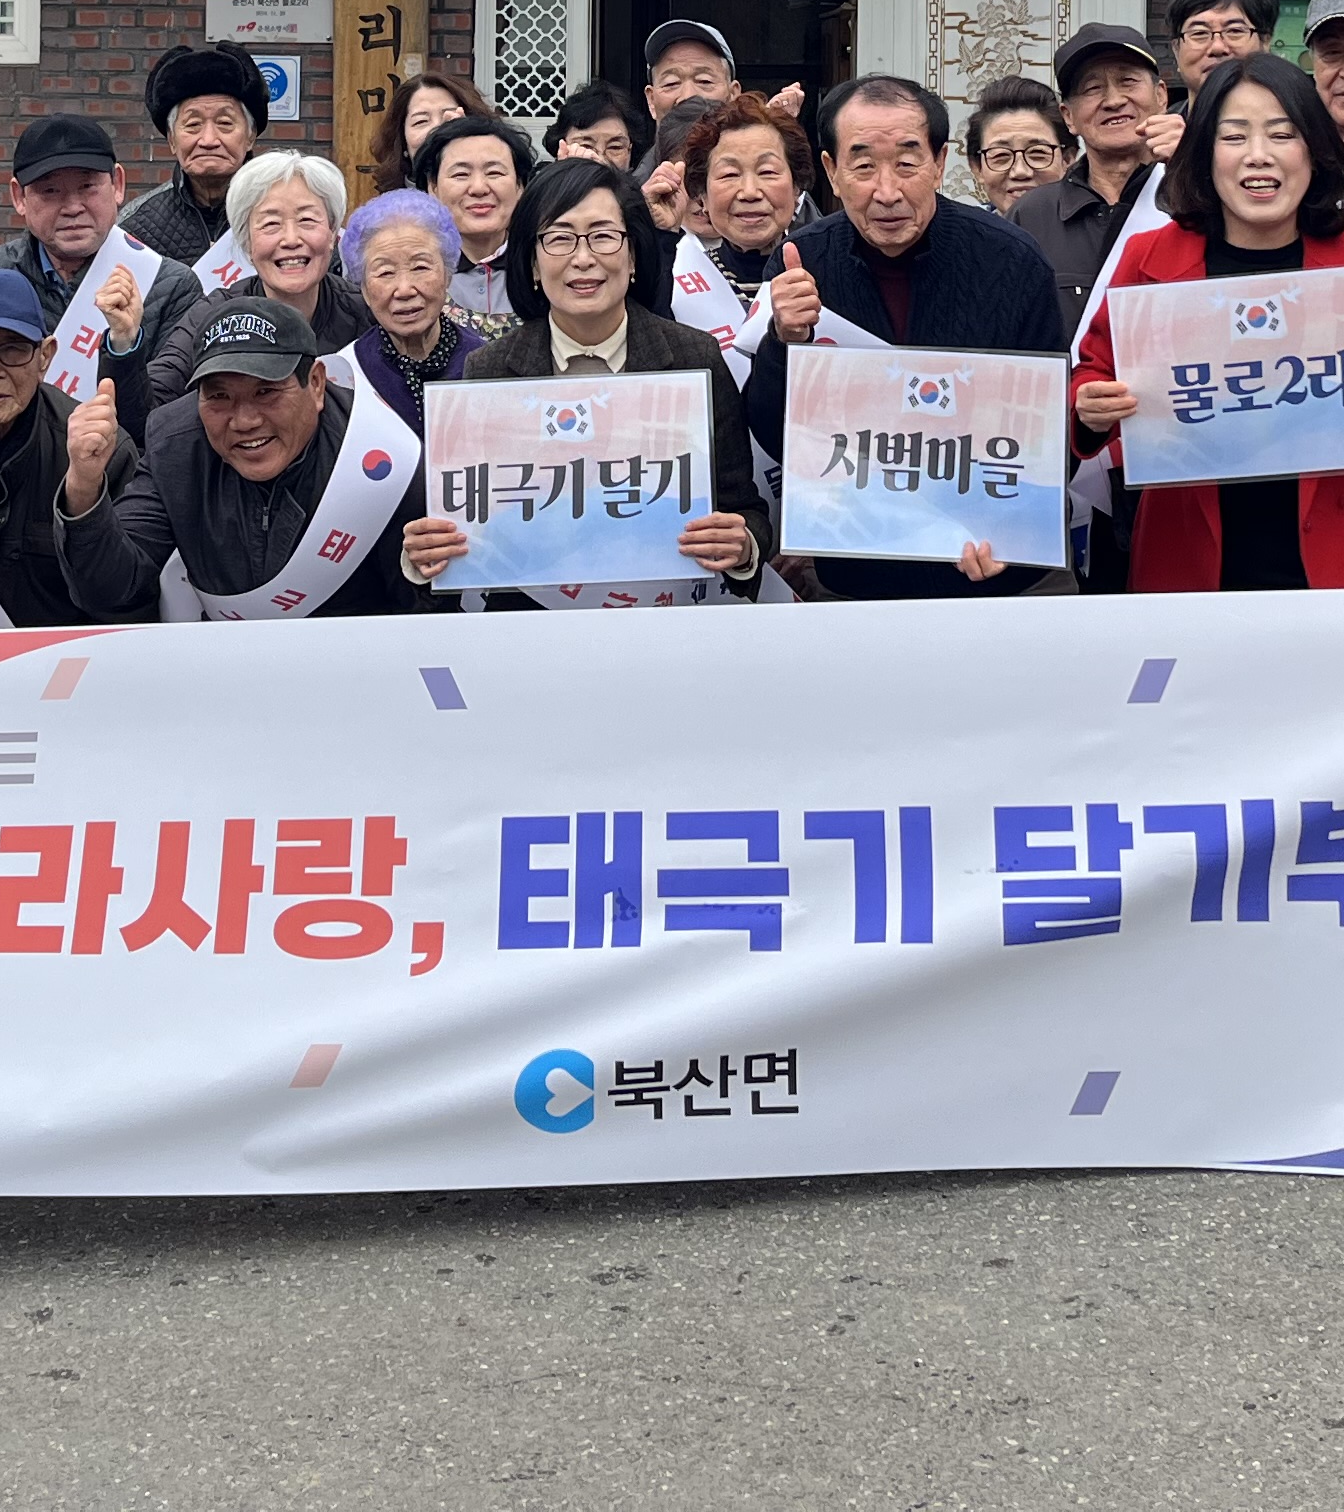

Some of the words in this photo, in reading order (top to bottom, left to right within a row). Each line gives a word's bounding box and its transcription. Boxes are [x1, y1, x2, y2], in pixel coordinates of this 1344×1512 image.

[230, 314, 277, 345] YORK
[441, 457, 585, 524] 태극기
[597, 452, 692, 519] 달기
[820, 429, 1025, 499] 시범마을
[497, 806, 933, 951] 태극기
[606, 1048, 801, 1120] 북산면
